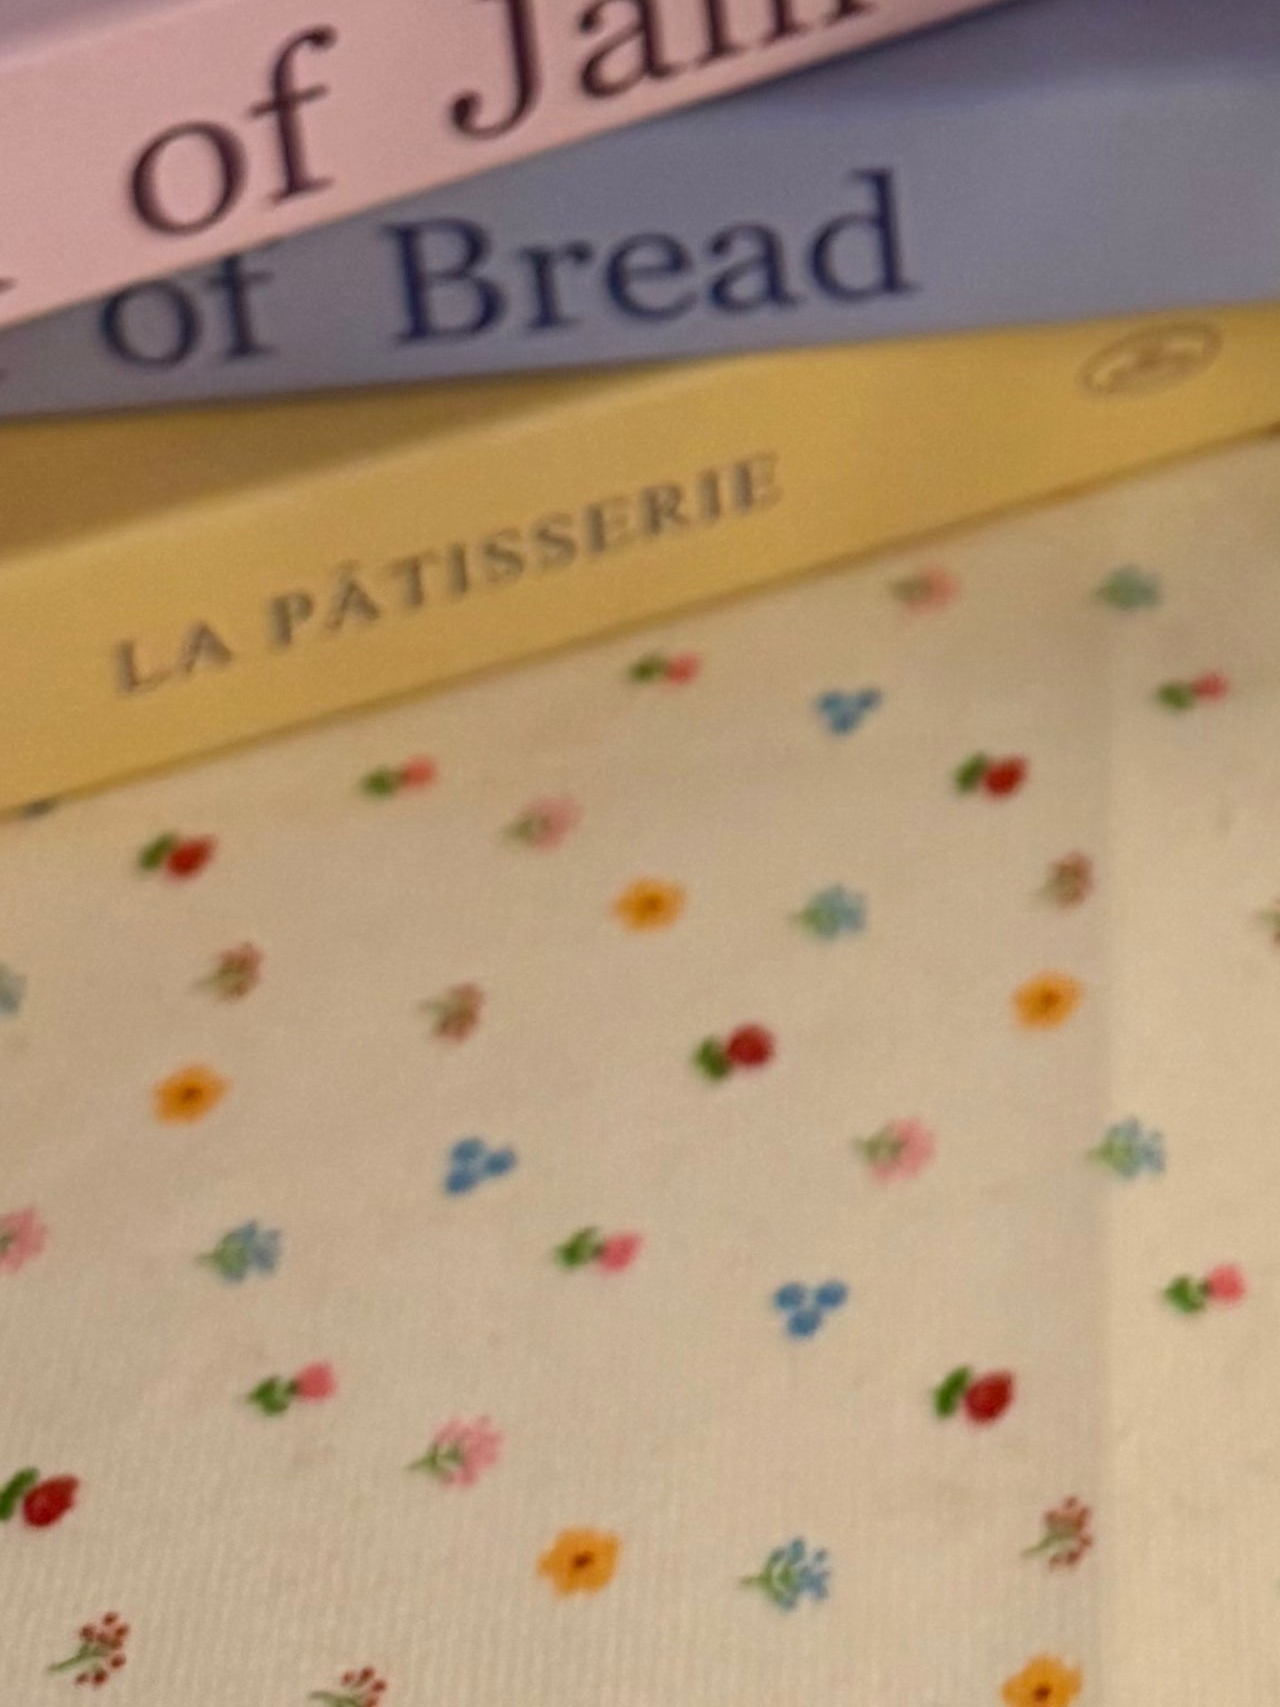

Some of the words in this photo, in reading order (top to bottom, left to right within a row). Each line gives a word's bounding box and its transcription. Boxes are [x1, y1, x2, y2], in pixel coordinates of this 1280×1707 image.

[128, 25, 338, 237] of
[99, 254, 276, 371] of
[382, 169, 919, 347] Bread
[113, 621, 233, 694] LA
[270, 453, 784, 647] PÂTISSERIE
